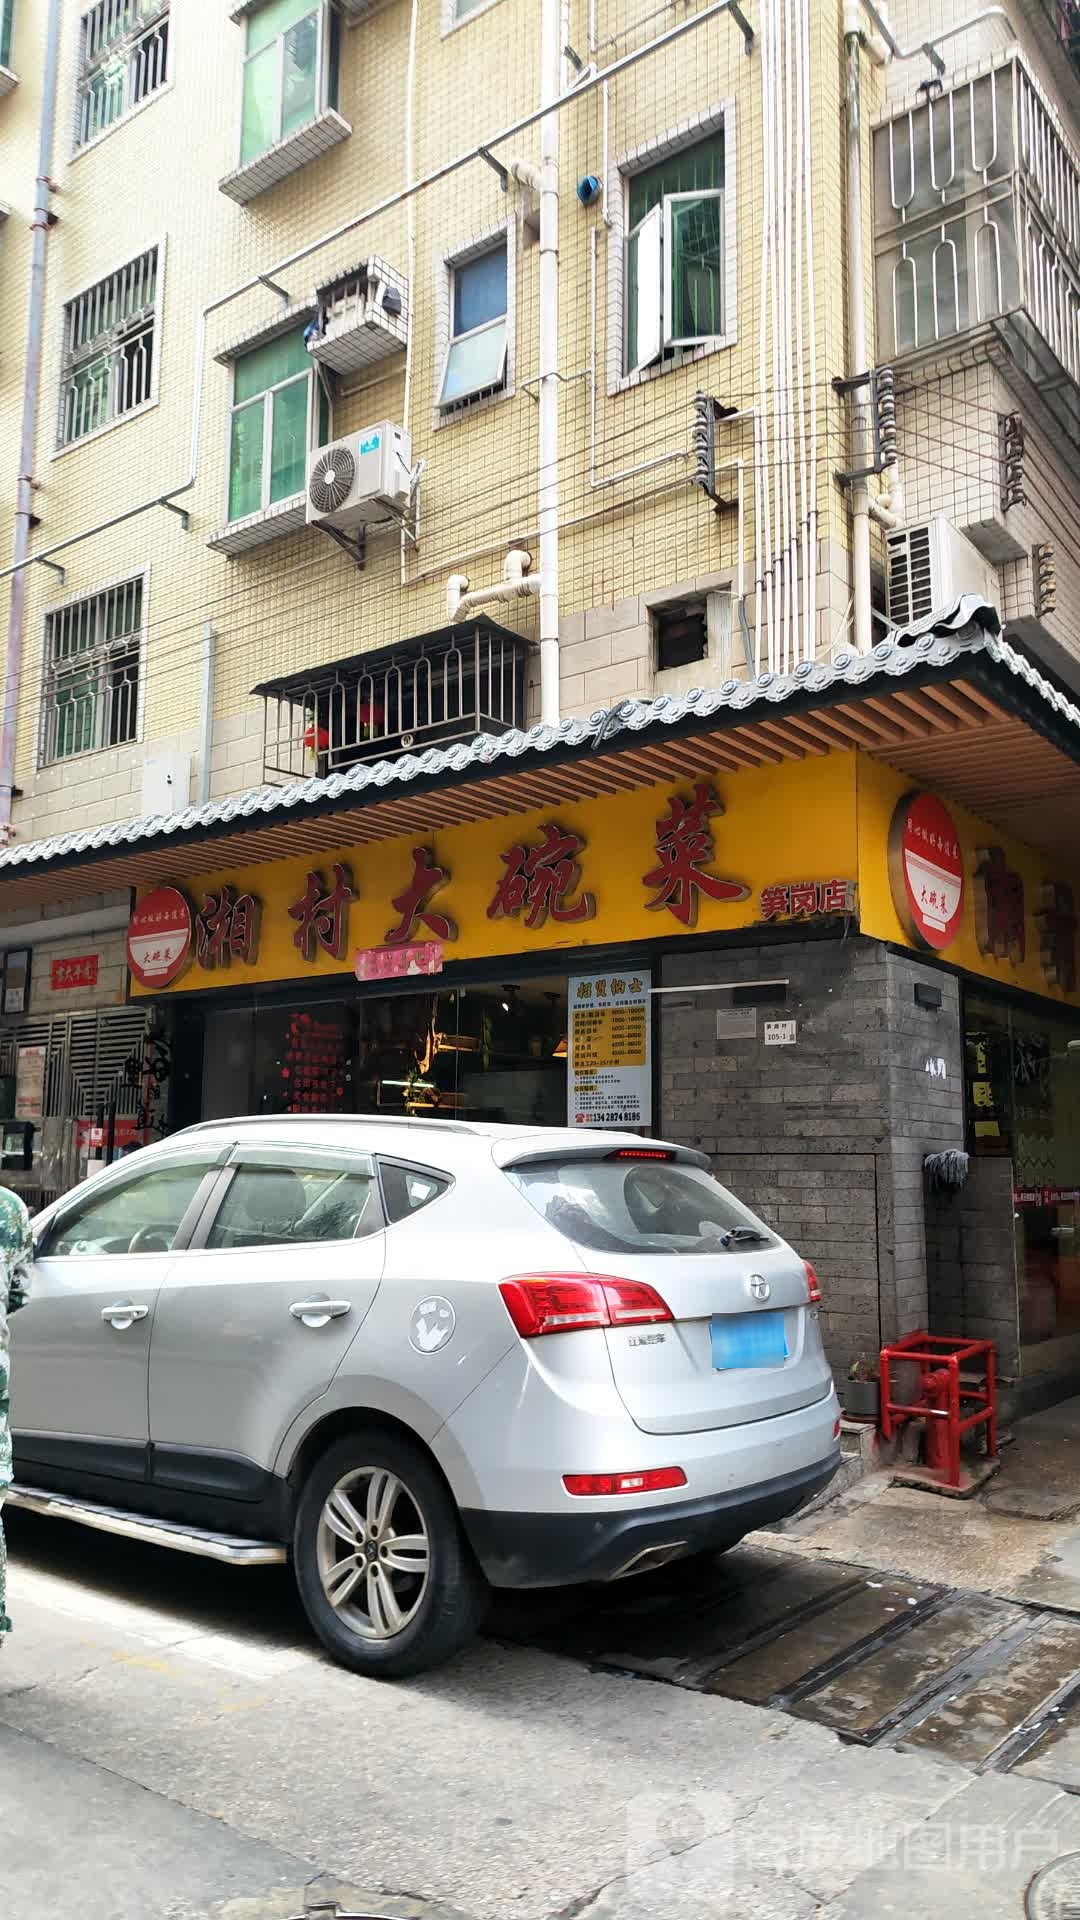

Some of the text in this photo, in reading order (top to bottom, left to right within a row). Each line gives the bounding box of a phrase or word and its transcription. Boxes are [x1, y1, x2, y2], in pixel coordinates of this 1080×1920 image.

[196, 783, 750, 971] 湘村大碗菜
[761, 879, 849, 920] 笋岗店
[920, 884, 949, 915] 大碗菜
[143, 946, 174, 964] 大碗菜
